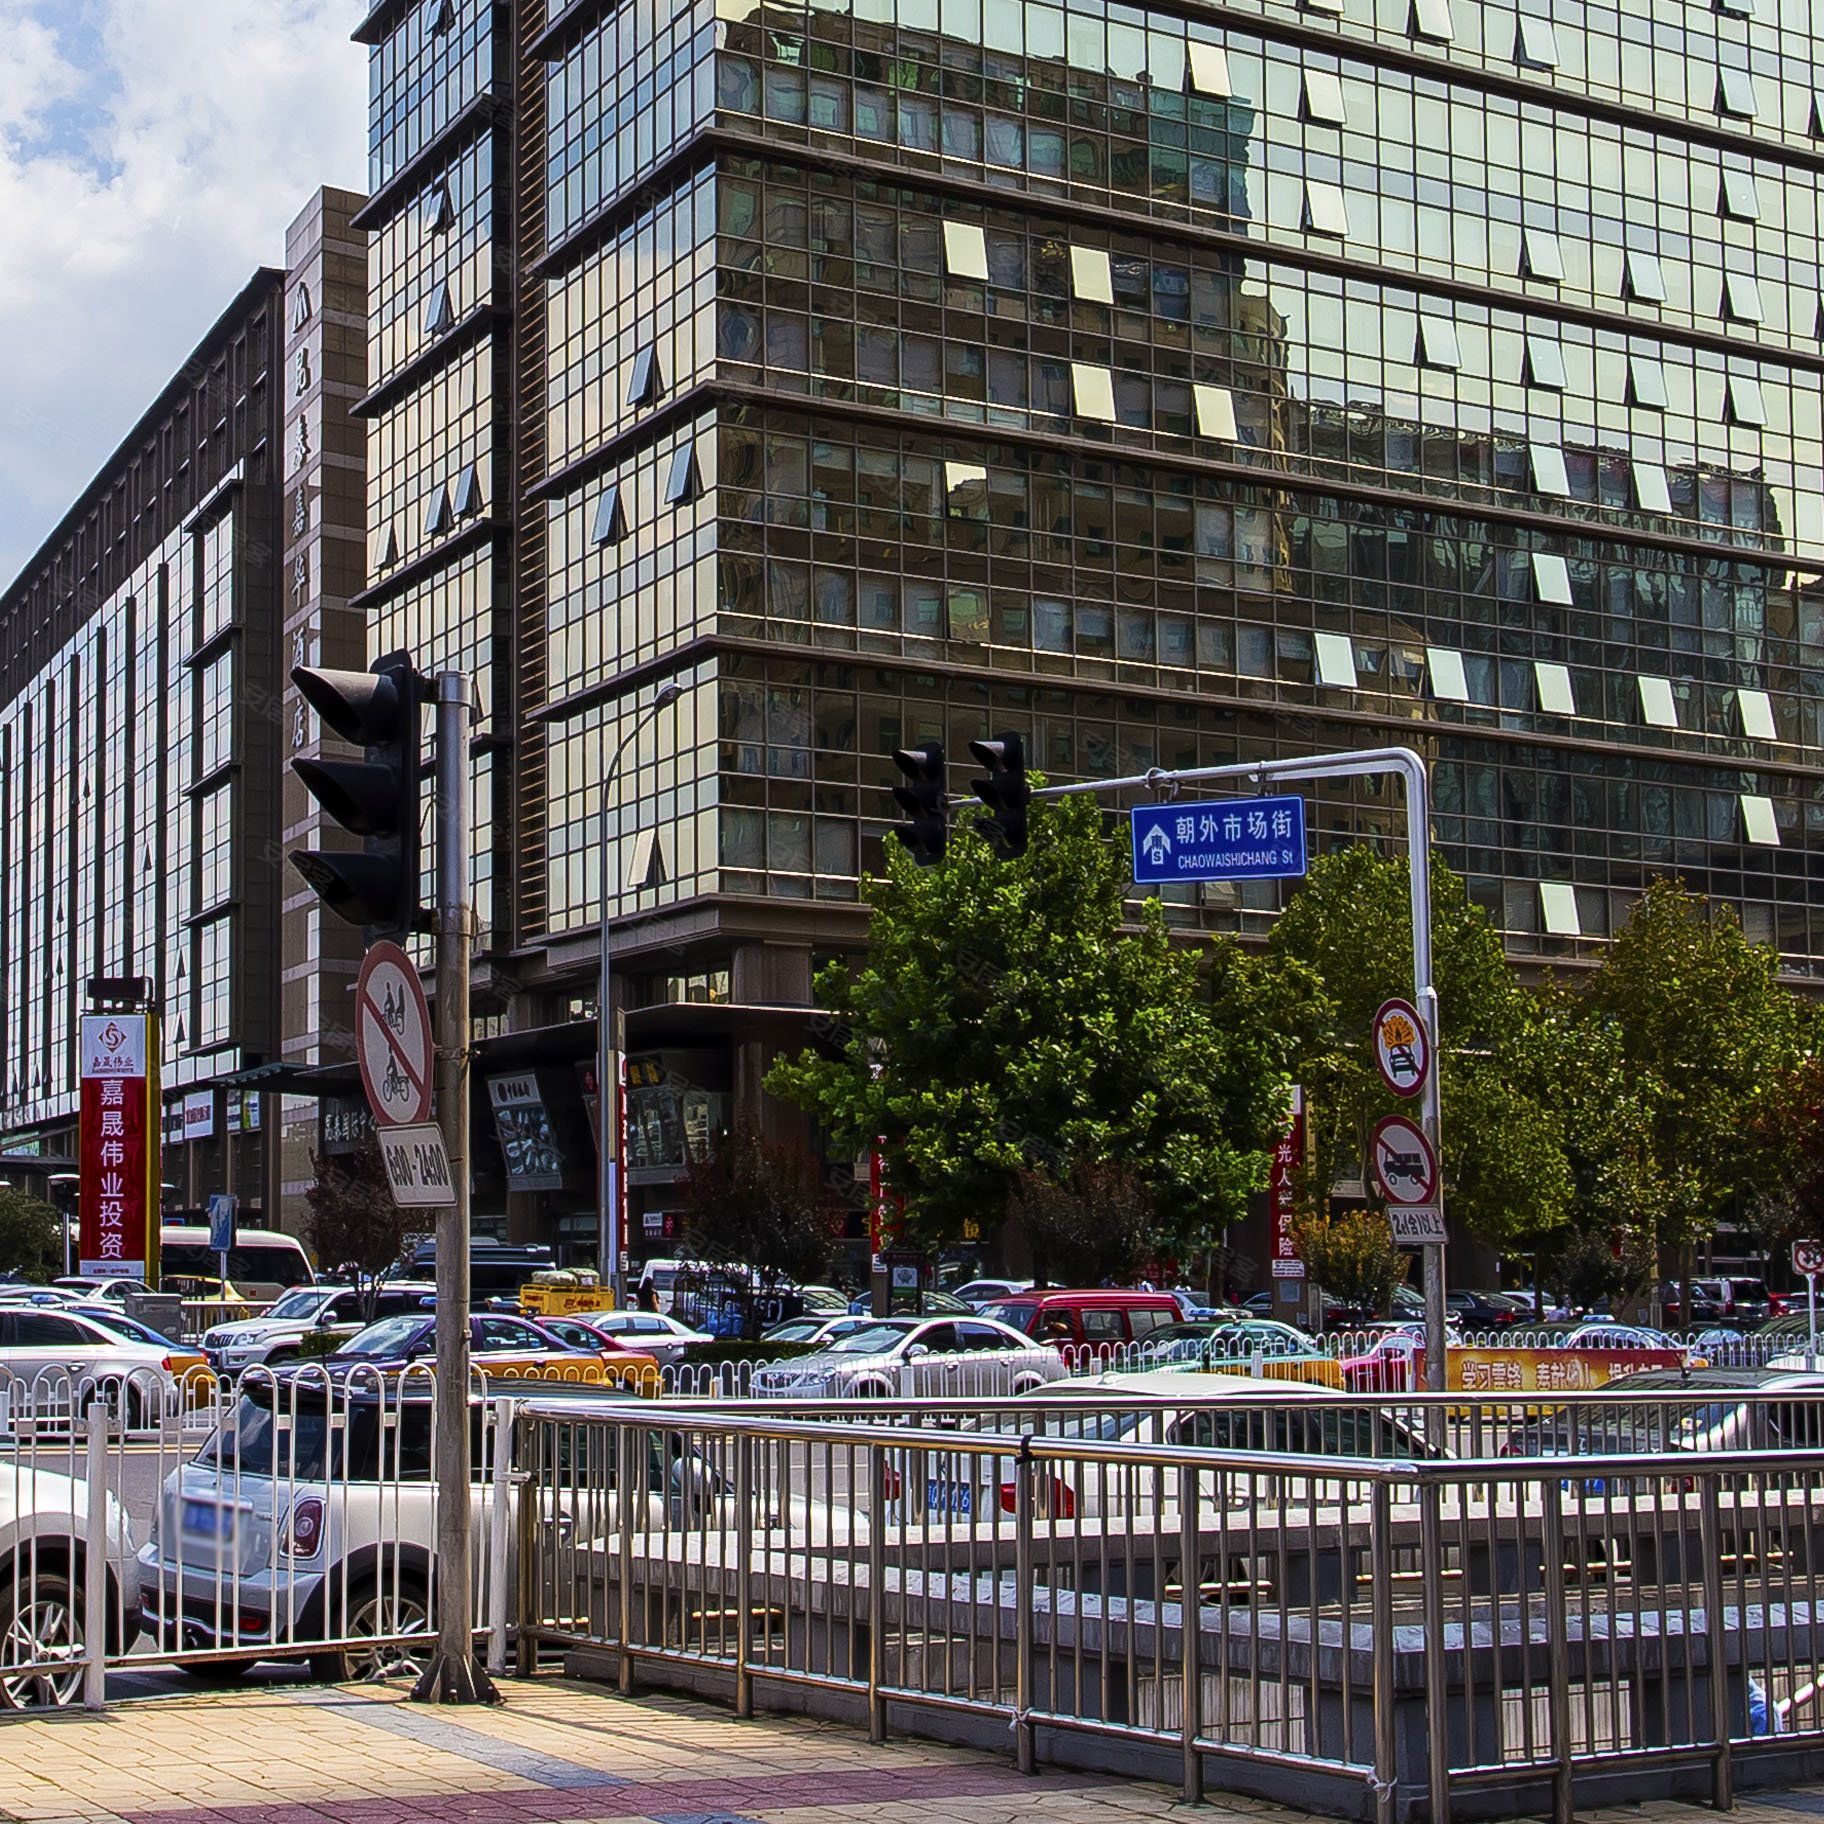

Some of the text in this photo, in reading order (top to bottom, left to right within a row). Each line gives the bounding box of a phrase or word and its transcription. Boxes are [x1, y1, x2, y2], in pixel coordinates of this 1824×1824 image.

[1176, 810, 1292, 844] 朝外市场街
[1178, 849, 1294, 869] CHAOWAISHICHANG St
[99, 1079, 125, 1259] 嘉晟伟业投资
